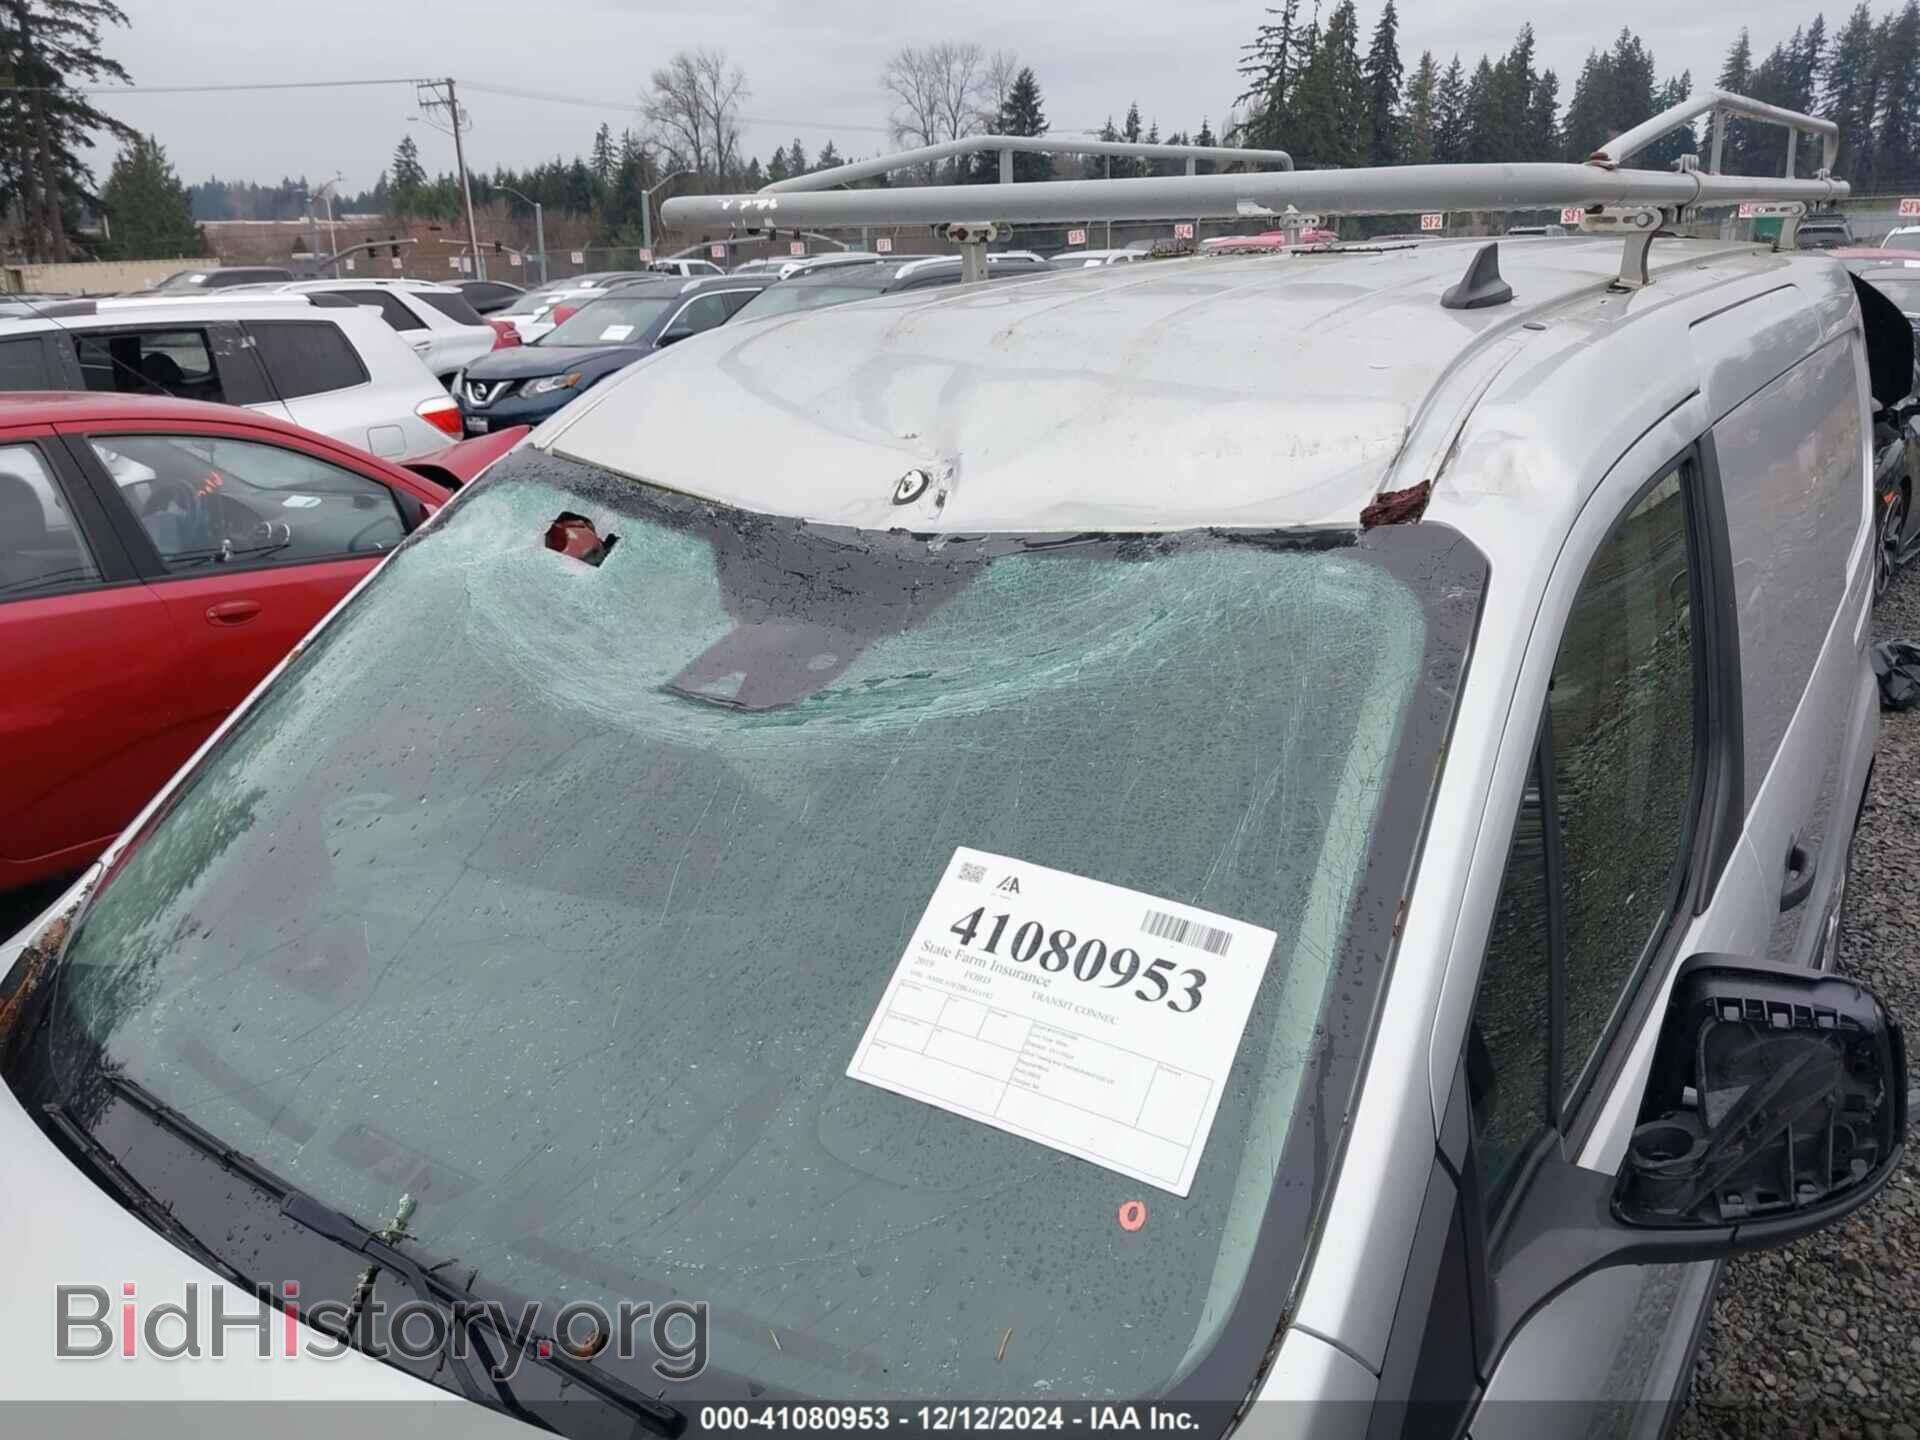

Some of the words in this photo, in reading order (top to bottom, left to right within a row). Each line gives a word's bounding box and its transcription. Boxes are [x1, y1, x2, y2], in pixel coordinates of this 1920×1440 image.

[1423, 215, 1441, 229] SF2
[920, 940, 952, 958] State
[954, 949, 987, 968] Farm
[990, 959, 1052, 987] Insurance
[949, 906, 1207, 1013] 41080953
[963, 970, 992, 985] FORD
[1031, 990, 1075, 1011] TRANSIT
[1074, 1003, 1120, 1025] CONNEC
